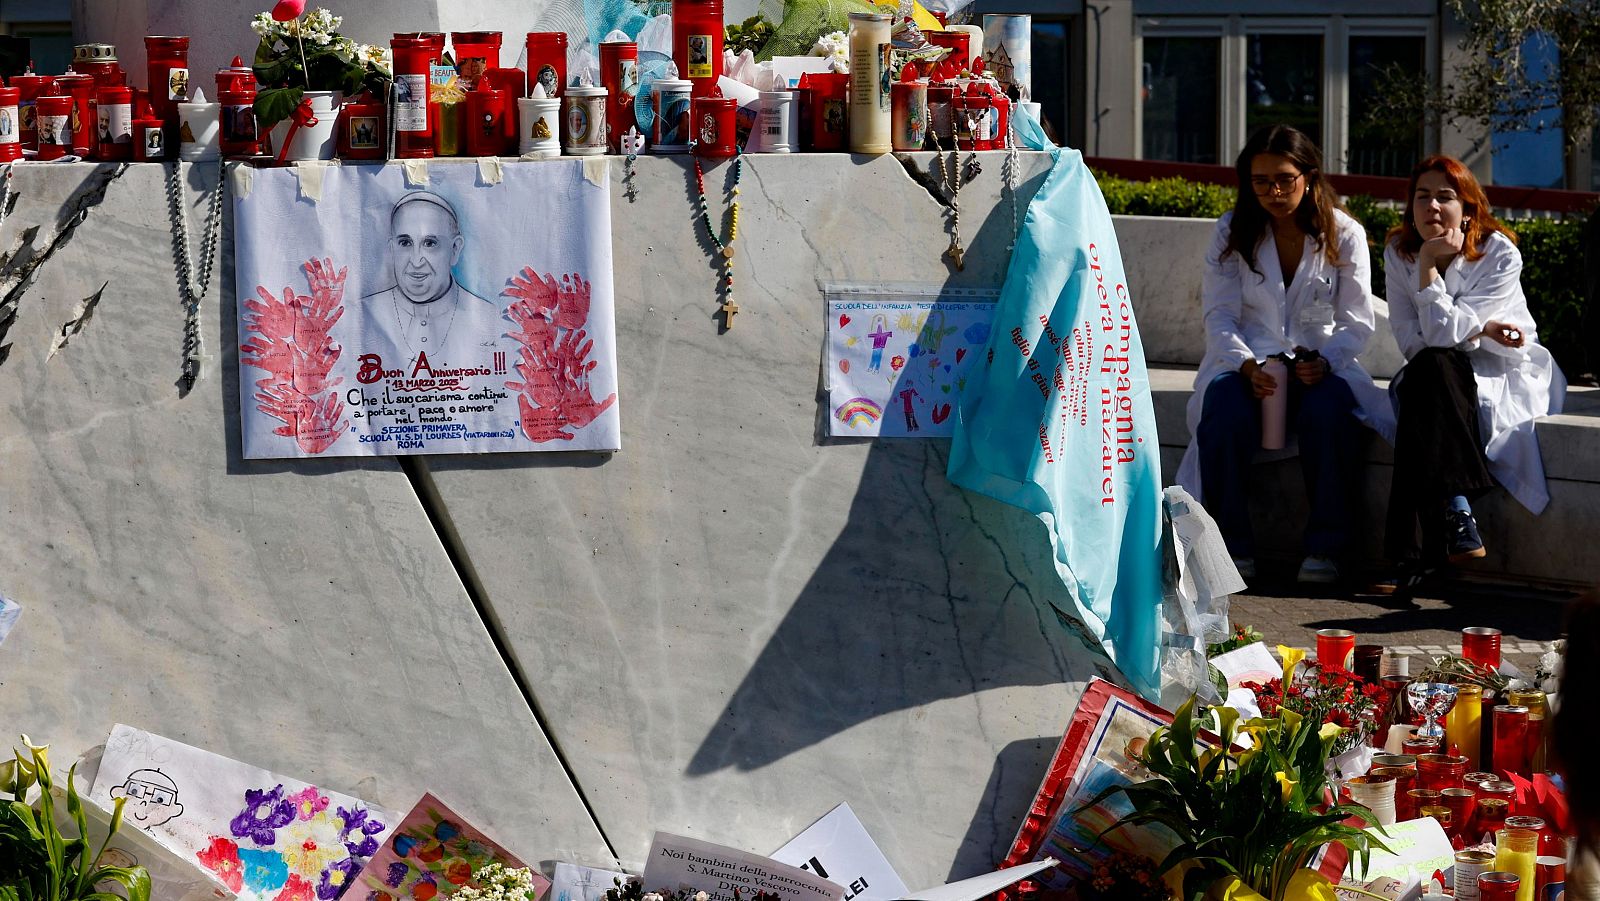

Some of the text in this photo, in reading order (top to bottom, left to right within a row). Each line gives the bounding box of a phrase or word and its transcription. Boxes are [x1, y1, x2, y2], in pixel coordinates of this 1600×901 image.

[1089, 243, 1115, 333] opera
[834, 303, 861, 311] SCUOLA
[1010, 326, 1030, 357] figlio
[1027, 358, 1041, 372] di
[1061, 335, 1075, 372] hanno
[1072, 327, 1086, 358] colui
[356, 353, 405, 384] Buon
[411, 350, 491, 379] Anniversario
[1080, 320, 1094, 427] abbiamo trovato
[1100, 344, 1118, 374] di
[1114, 283, 1143, 465] compagnia
[346, 386, 509, 407] Che il suo carisma continui
[405, 379, 437, 388] MARZO
[353, 410, 365, 419] a
[367, 406, 407, 425] portare
[449, 405, 457, 414] e
[380, 423, 468, 435] SEZIONE PRIMAVERA
[395, 414, 415, 425] nel
[358, 433, 393, 443] SCUOLA
[425, 431, 462, 441] LOURDES
[396, 440, 426, 449] ROMA
[660, 847, 832, 898] Noi bambini della parrocchia
[686, 863, 801, 896] S. Martino Vescovo
[718, 880, 758, 897] DROS
